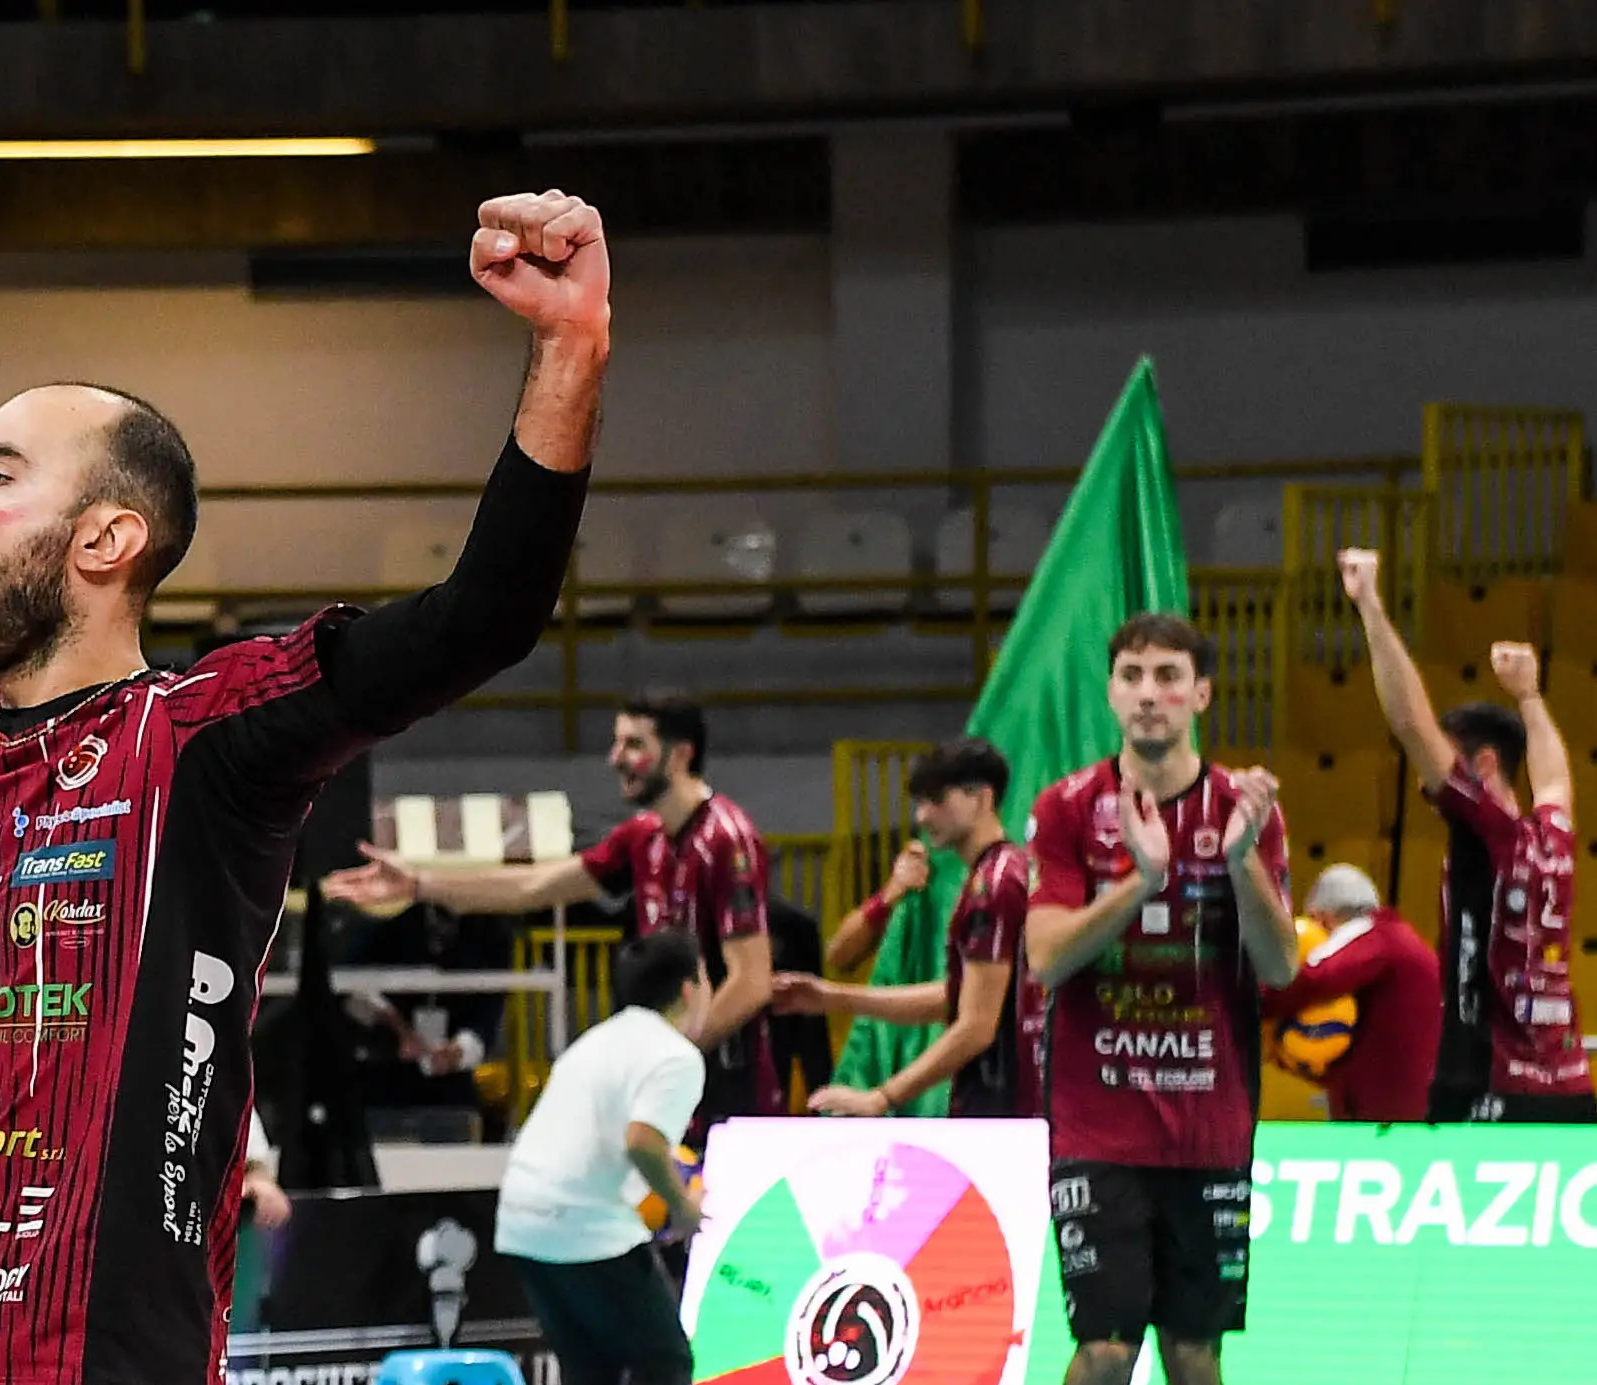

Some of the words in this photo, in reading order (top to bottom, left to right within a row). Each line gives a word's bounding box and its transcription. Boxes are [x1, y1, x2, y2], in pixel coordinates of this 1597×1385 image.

[1094, 1027, 1214, 1060] CANALE
[165, 1083, 181, 1124] per
[158, 1161, 186, 1242] Sport
